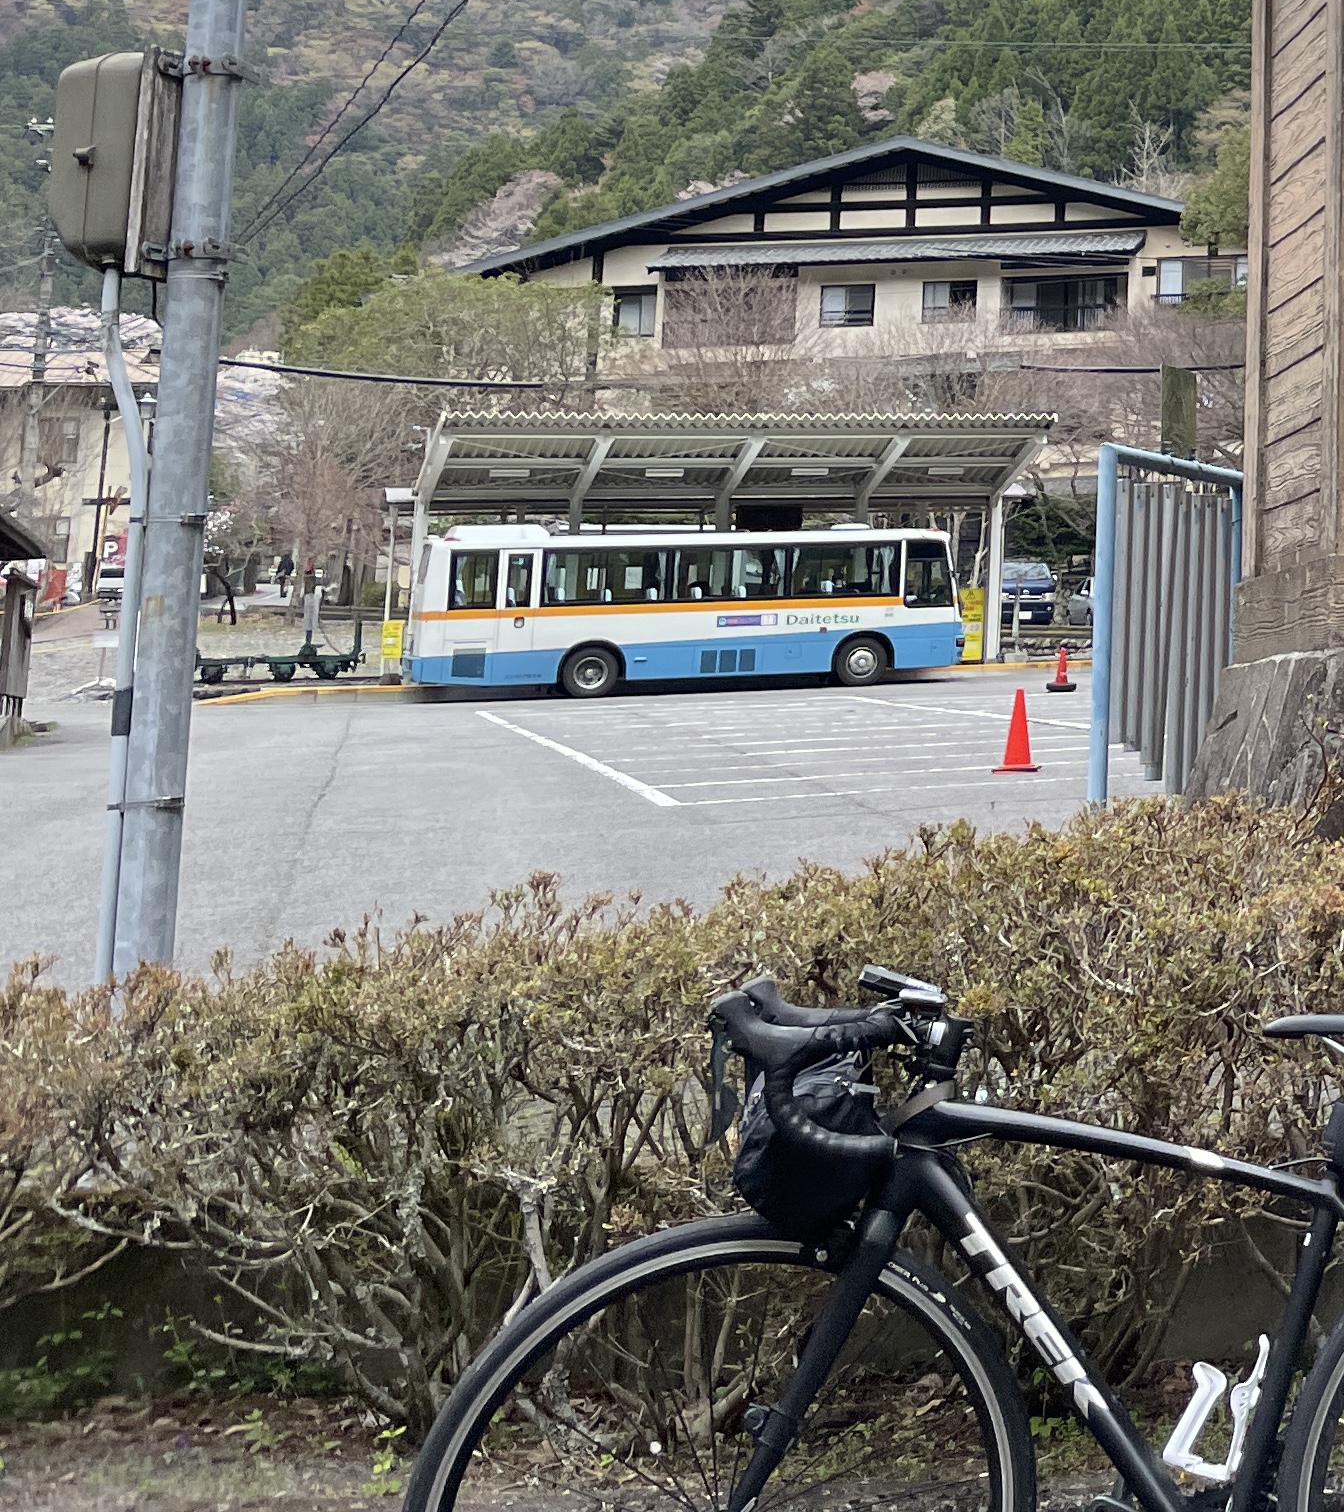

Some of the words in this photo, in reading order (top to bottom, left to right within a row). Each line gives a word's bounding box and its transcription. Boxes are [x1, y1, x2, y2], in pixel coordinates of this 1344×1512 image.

[103, 541, 119, 559] P
[786, 613, 860, 626] Daitetsu
[960, 1212, 1110, 1420] TREK
